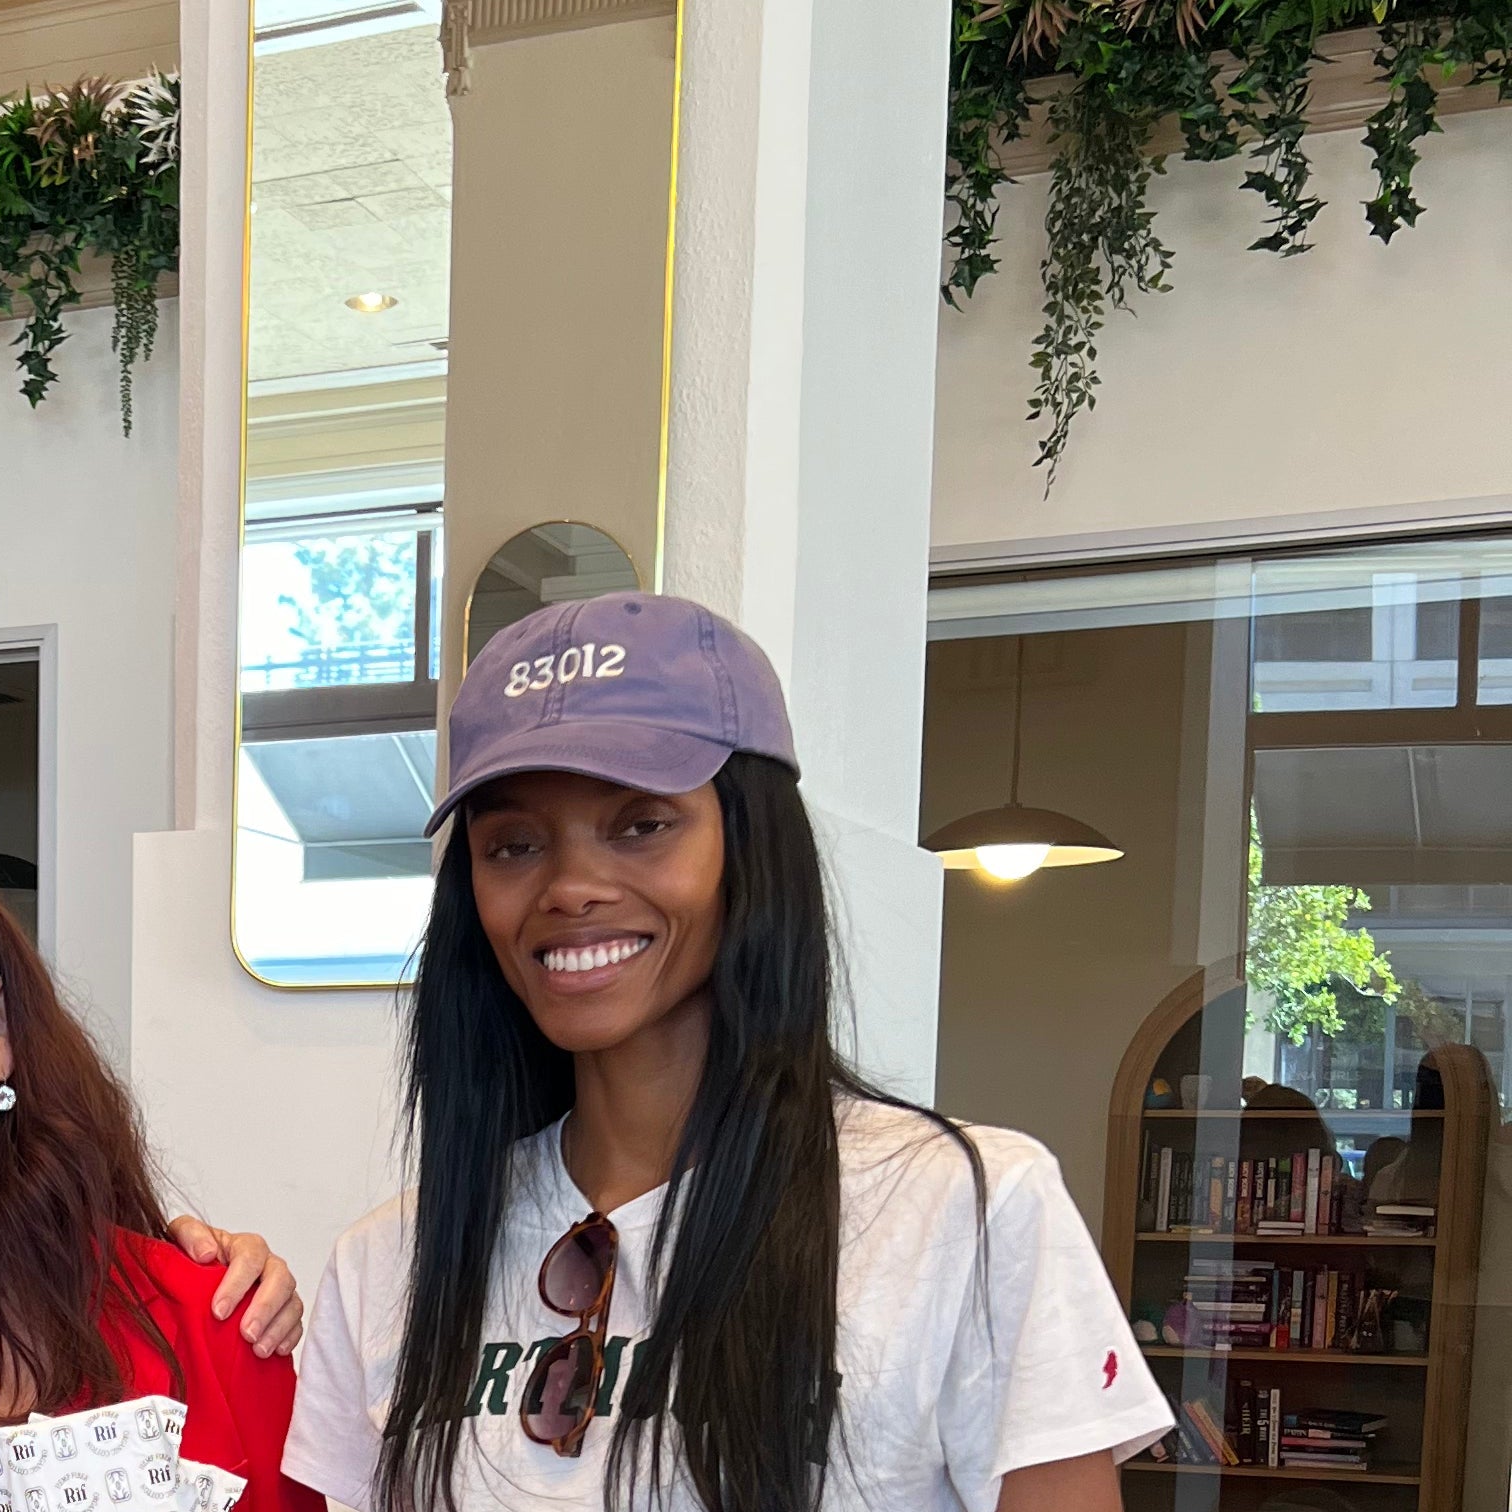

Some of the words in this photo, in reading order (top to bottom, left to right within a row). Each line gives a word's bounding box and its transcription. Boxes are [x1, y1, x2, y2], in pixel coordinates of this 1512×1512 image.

[503, 643, 626, 698] 83012
[94, 1422, 117, 1442] Rif
[164, 1418, 183, 1435] Ri
[12, 1440, 36, 1462] Rif
[147, 1465, 171, 1485] Rif
[64, 1484, 87, 1504] Rif
